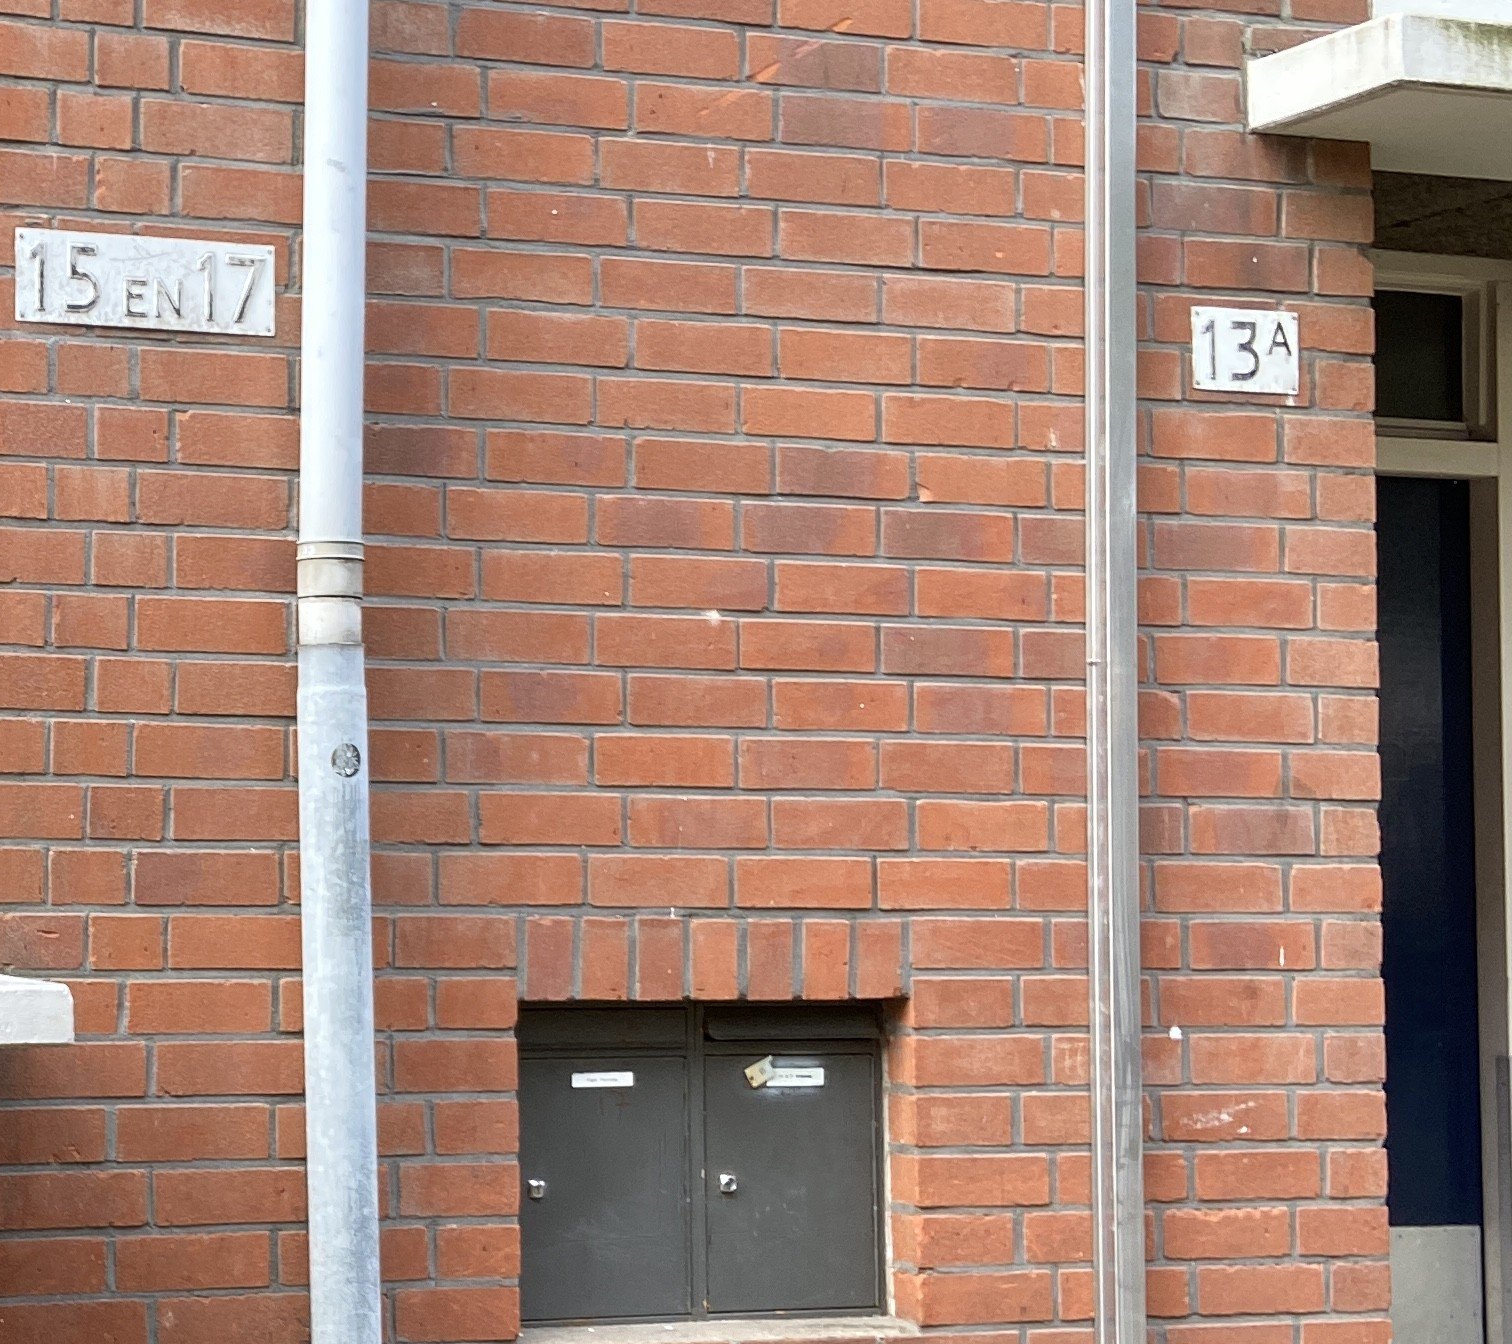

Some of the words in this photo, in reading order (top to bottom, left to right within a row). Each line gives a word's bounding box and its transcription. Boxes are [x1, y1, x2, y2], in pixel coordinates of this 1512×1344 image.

[29, 241, 100, 313] 15
[122, 275, 185, 319] EN
[196, 251, 268, 324] 17
